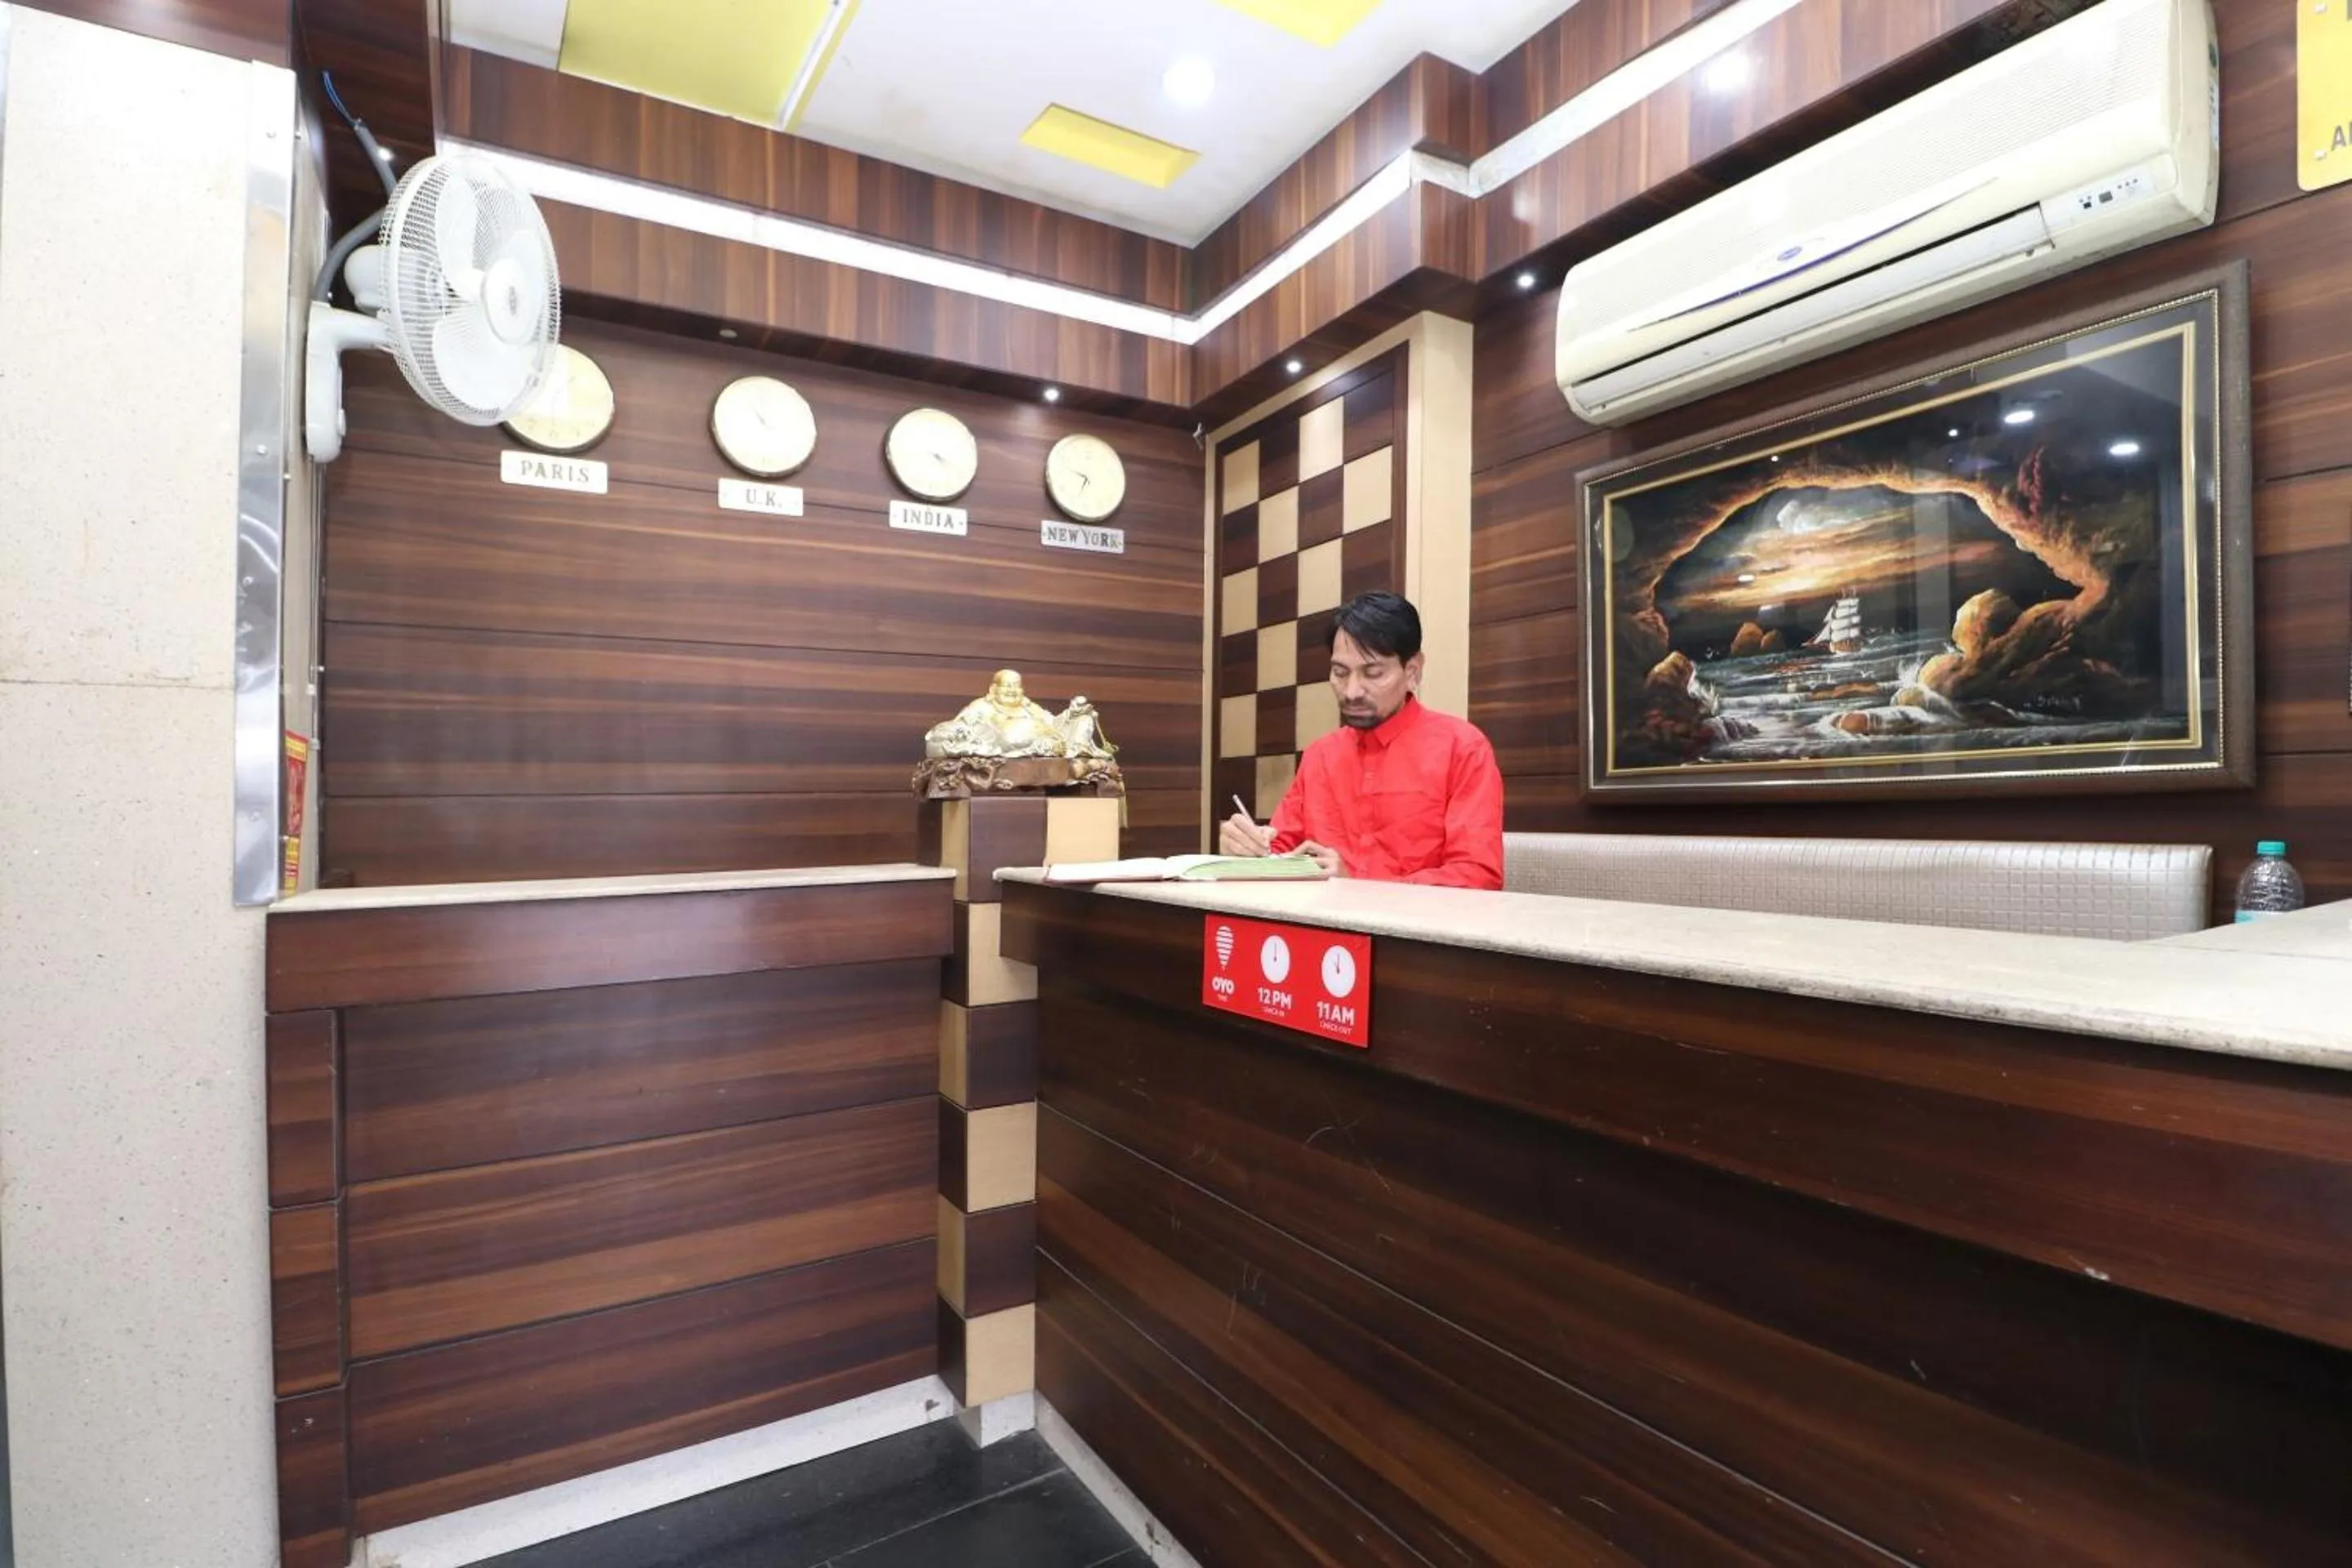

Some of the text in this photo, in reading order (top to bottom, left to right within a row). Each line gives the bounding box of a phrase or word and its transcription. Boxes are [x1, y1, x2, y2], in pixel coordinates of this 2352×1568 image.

[520, 459, 589, 483] PARIS
[902, 508, 955, 529] INDIA
[1212, 976, 1234, 995] OYO
